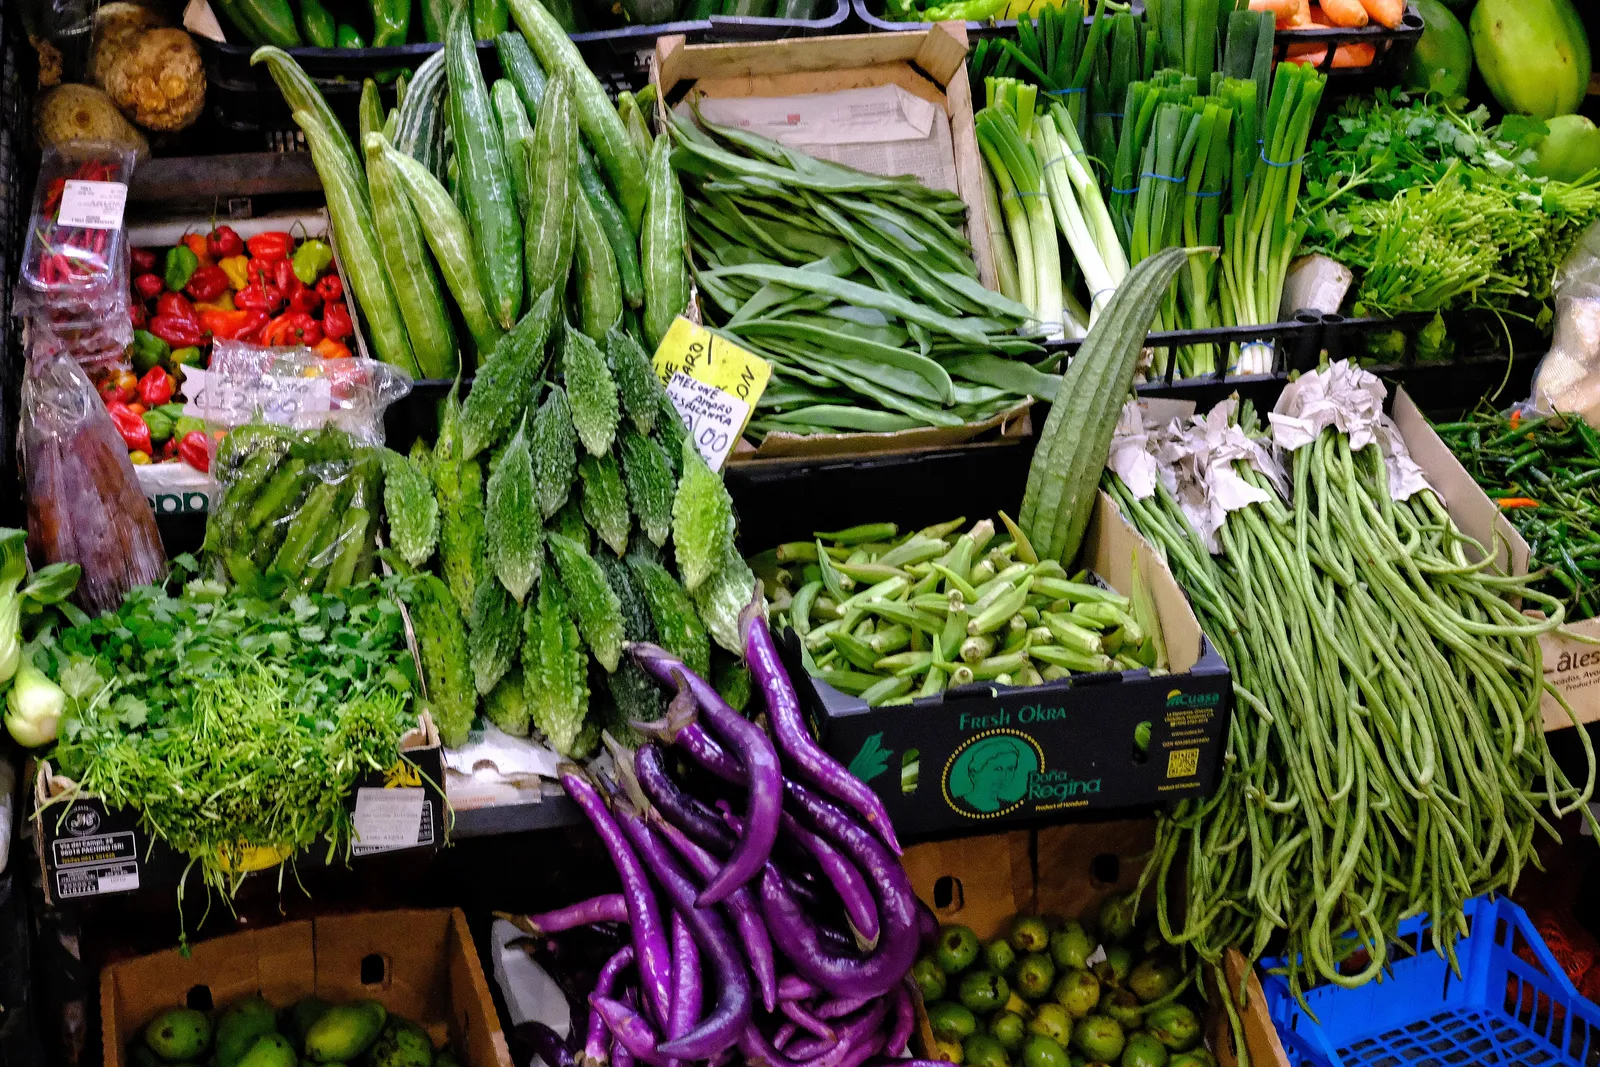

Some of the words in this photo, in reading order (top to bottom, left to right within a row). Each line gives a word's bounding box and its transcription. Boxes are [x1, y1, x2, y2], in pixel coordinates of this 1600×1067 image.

[681, 342, 704, 377] ARO
[736, 364, 755, 401] ON
[1029, 778, 1102, 801] Regina
[1035, 804, 1056, 812] Product
